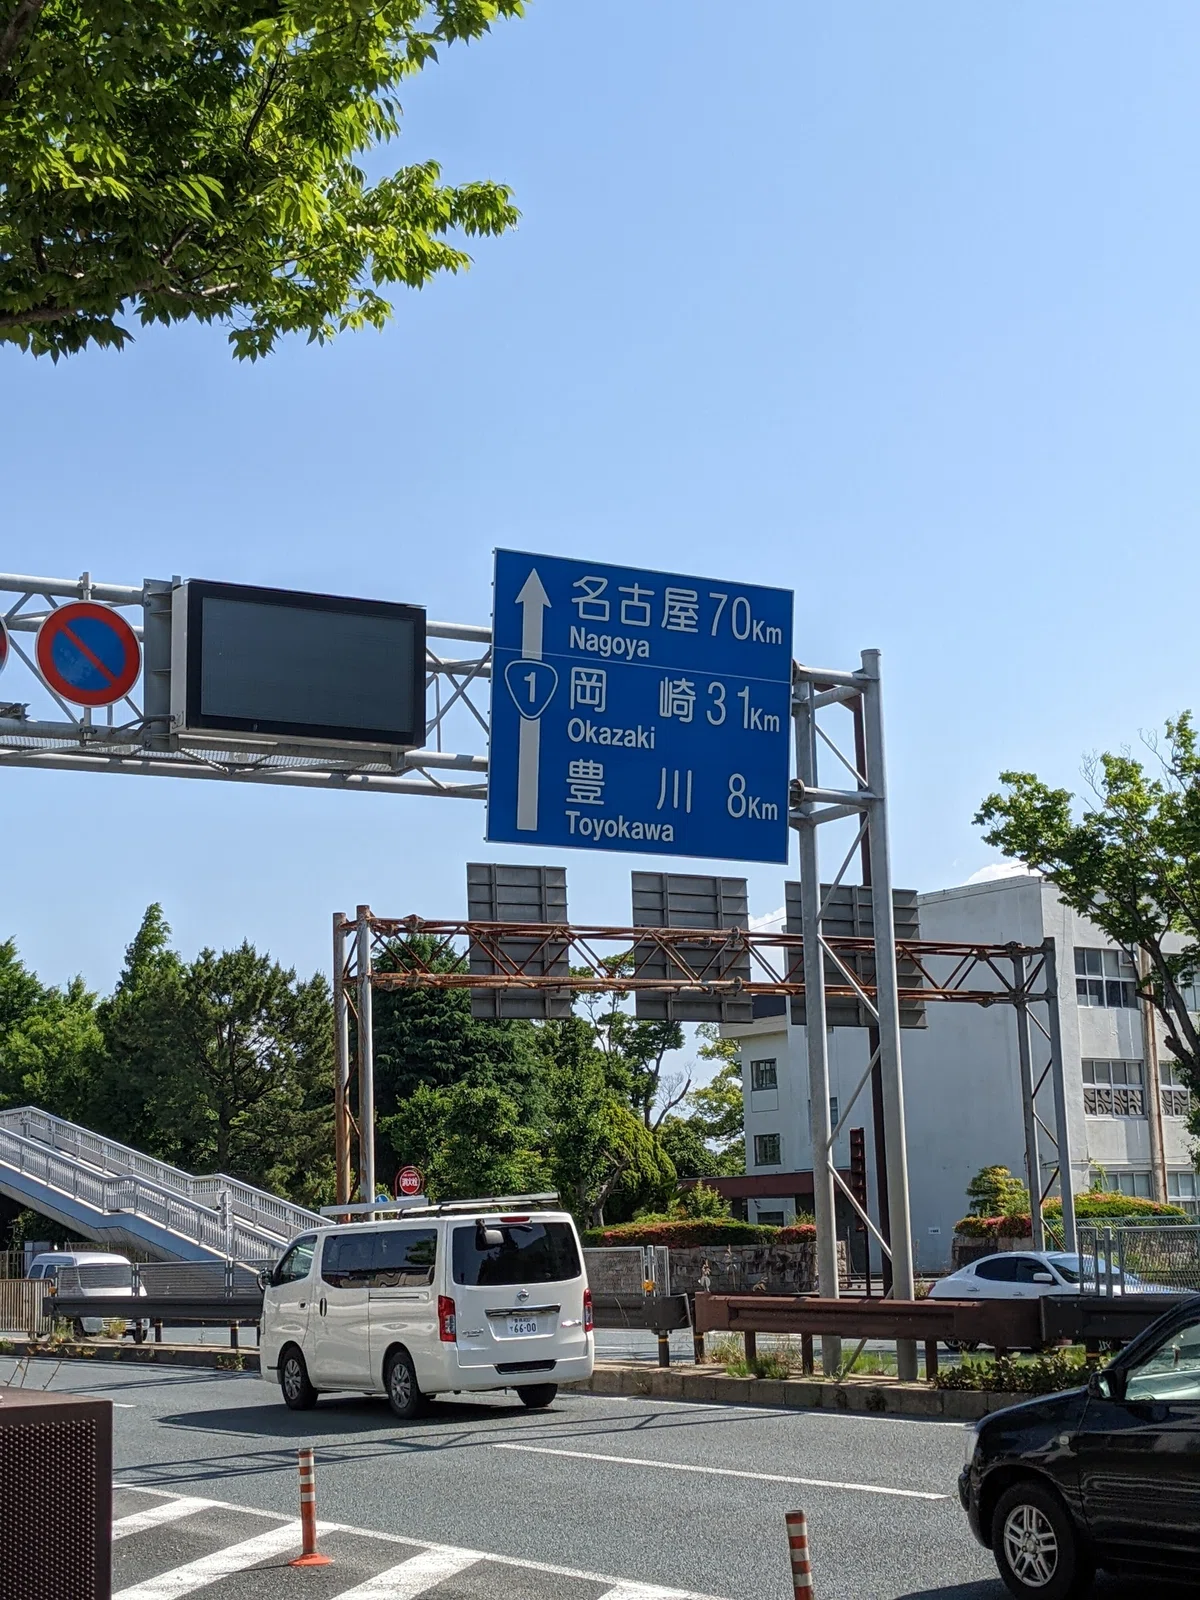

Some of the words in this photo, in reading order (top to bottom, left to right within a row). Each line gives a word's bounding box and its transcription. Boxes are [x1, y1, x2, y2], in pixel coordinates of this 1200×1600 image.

[571, 575, 699, 633] 名古屋
[569, 626, 650, 660] Nagoya
[523, 671, 536, 703] 1
[567, 717, 655, 749] Okazaki
[565, 810, 674, 842] Toyokawa
